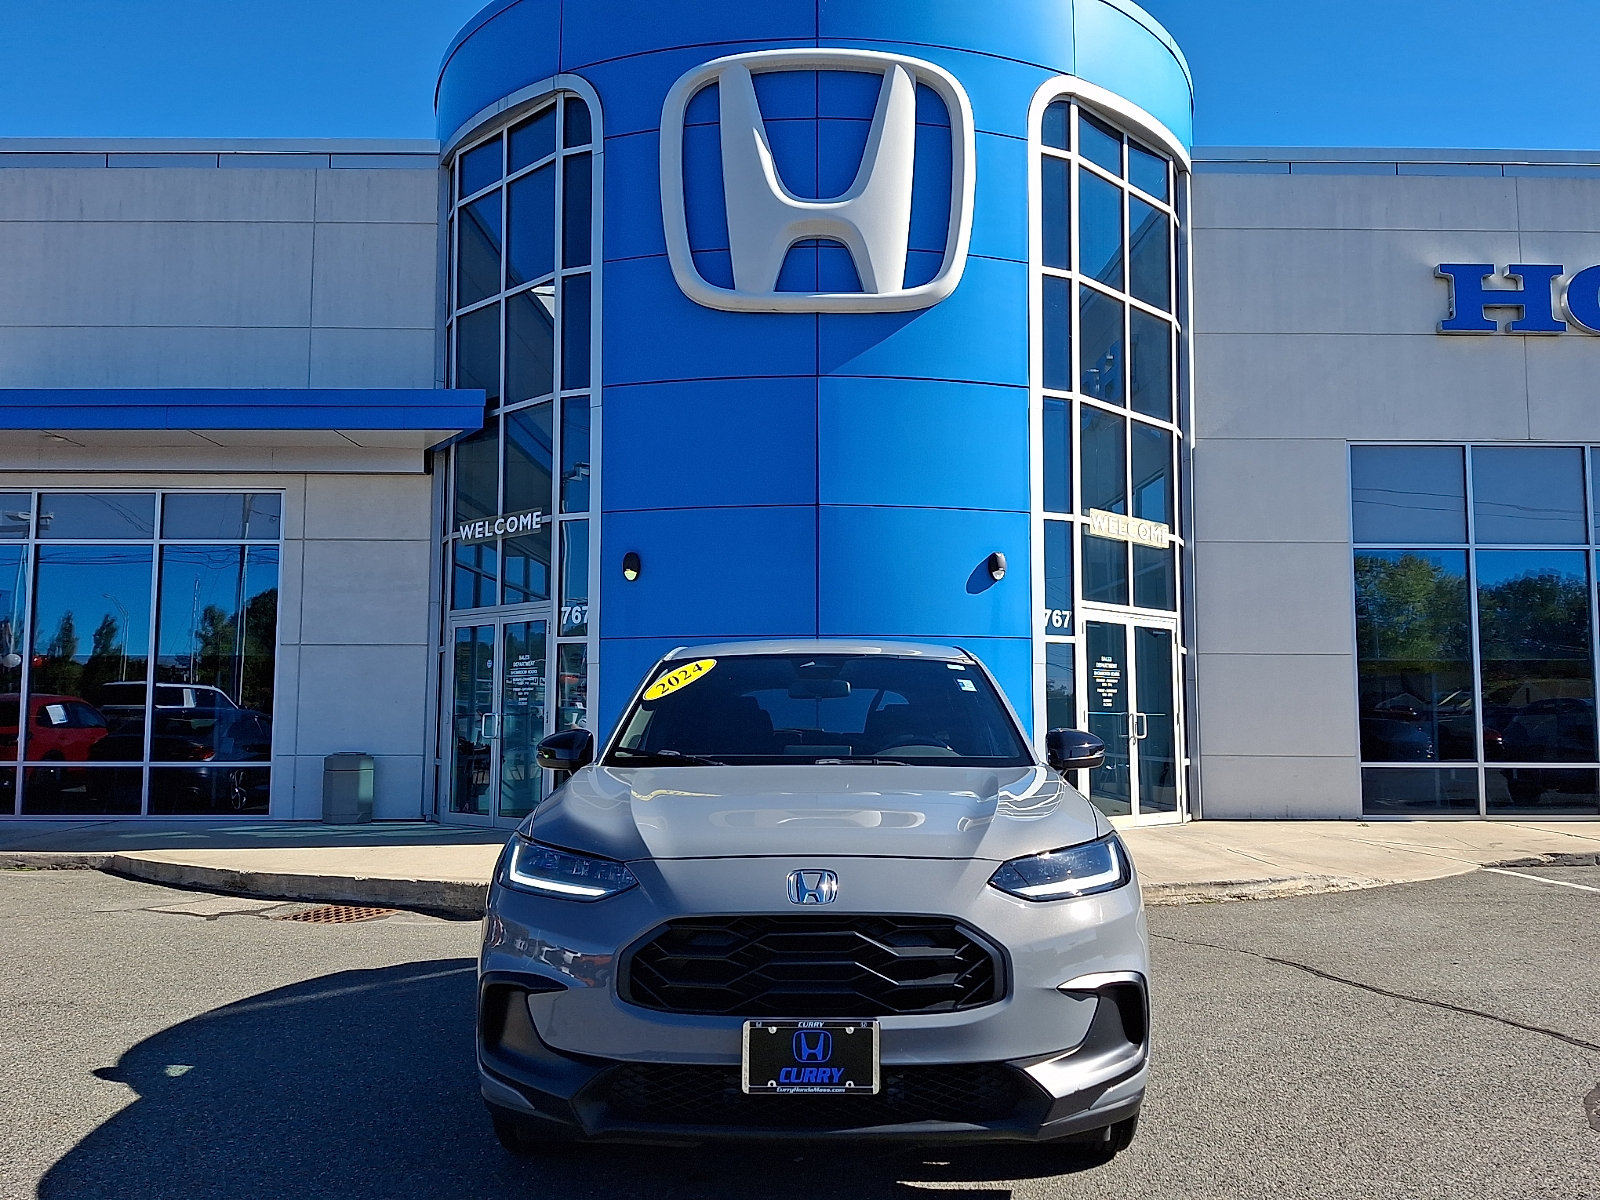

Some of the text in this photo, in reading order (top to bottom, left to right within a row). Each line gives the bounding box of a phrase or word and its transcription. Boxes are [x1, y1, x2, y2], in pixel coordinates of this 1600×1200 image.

[460, 511, 542, 541] WELCOME
[1090, 513, 1169, 545] WELCOME
[561, 606, 589, 625] 767
[1044, 609, 1072, 628] 767
[655, 663, 703, 694] 2024
[779, 1067, 845, 1083] CURRY
[776, 1086, 846, 1094] CurryHondaMass.com
